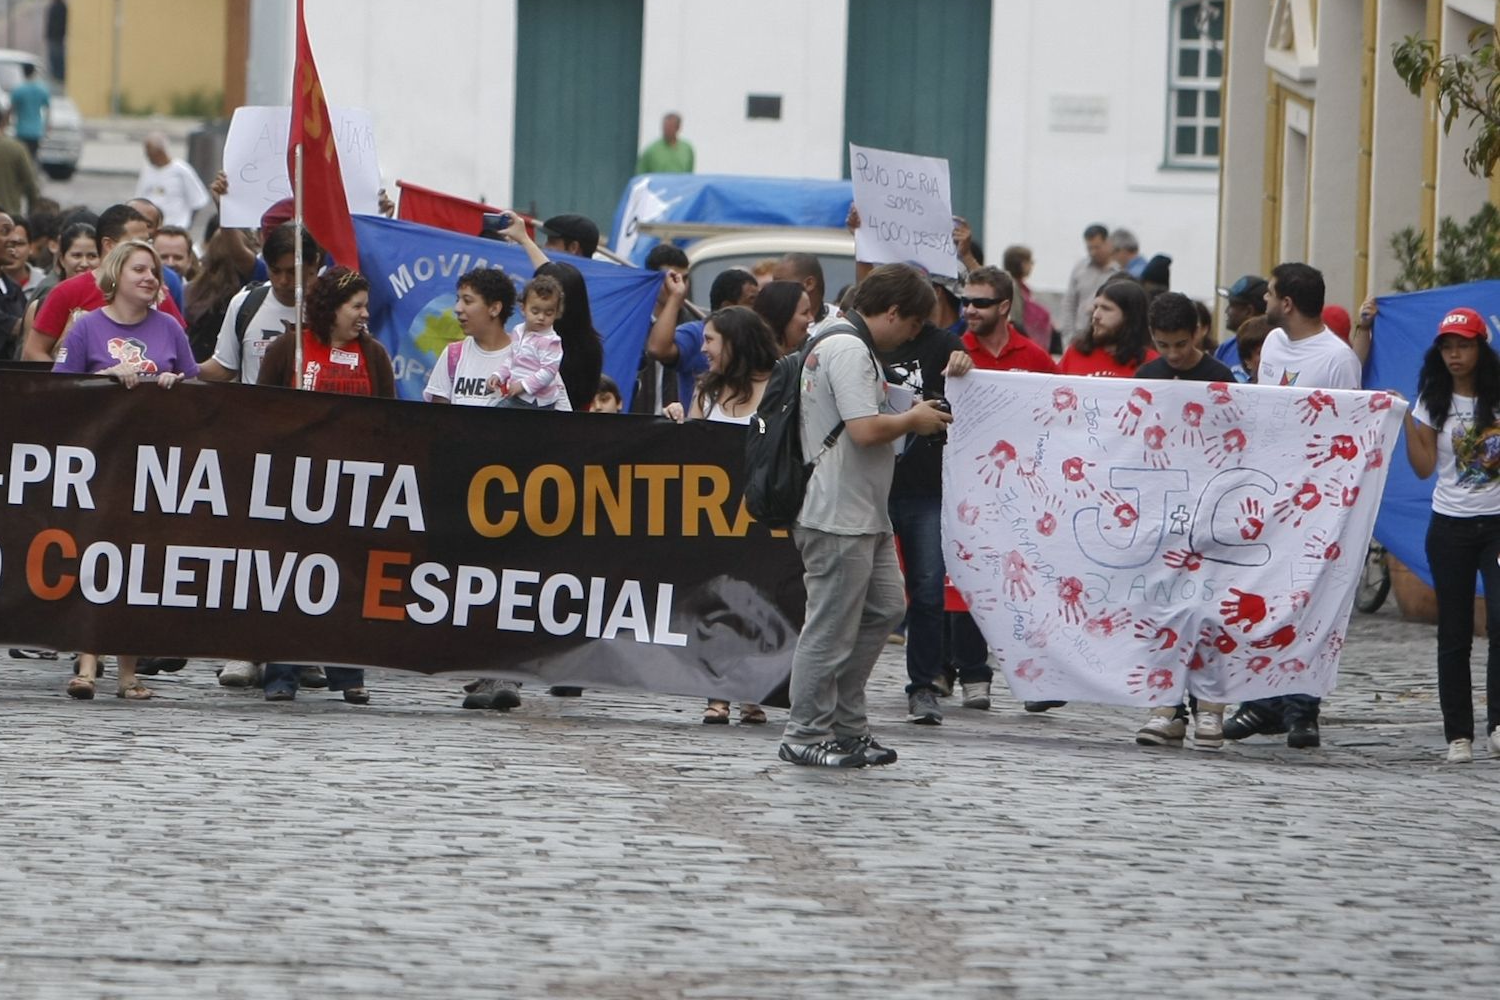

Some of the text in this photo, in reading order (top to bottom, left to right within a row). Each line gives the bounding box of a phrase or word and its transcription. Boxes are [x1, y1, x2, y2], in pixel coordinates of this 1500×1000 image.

[868, 215, 911, 246] 4000
[132, 444, 229, 517] NA
[248, 452, 426, 532] LUTA
[25, 527, 341, 616] COLETIVO
[361, 549, 689, 647] ESPECIAL
[1084, 572, 1215, 605] 2 ANOS
